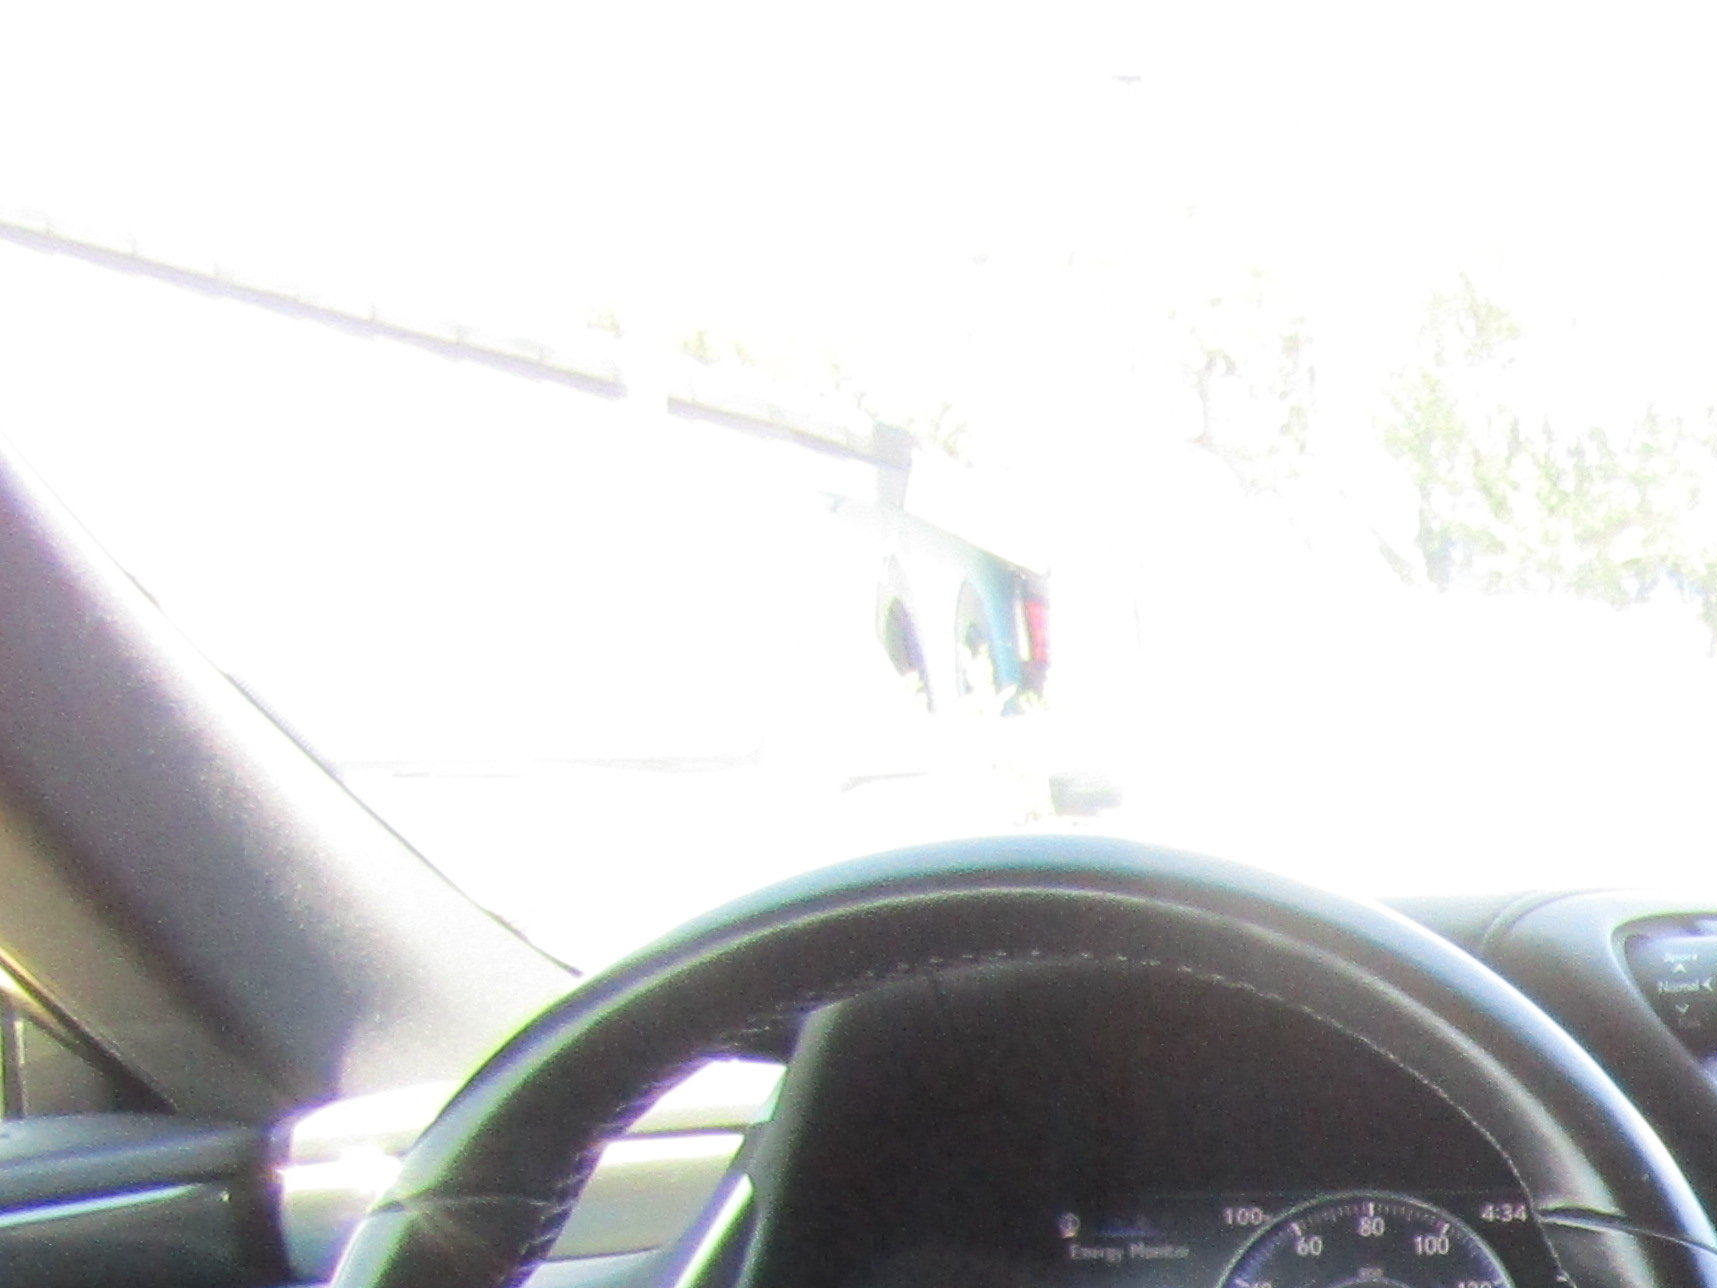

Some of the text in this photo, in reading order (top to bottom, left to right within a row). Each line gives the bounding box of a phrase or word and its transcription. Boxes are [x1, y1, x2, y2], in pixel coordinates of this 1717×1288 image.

[1481, 1203, 1527, 1222] 4:34
[1359, 1216, 1385, 1237] 80
[1296, 1235, 1322, 1256] 60
[1414, 1235, 1449, 1255] 100
